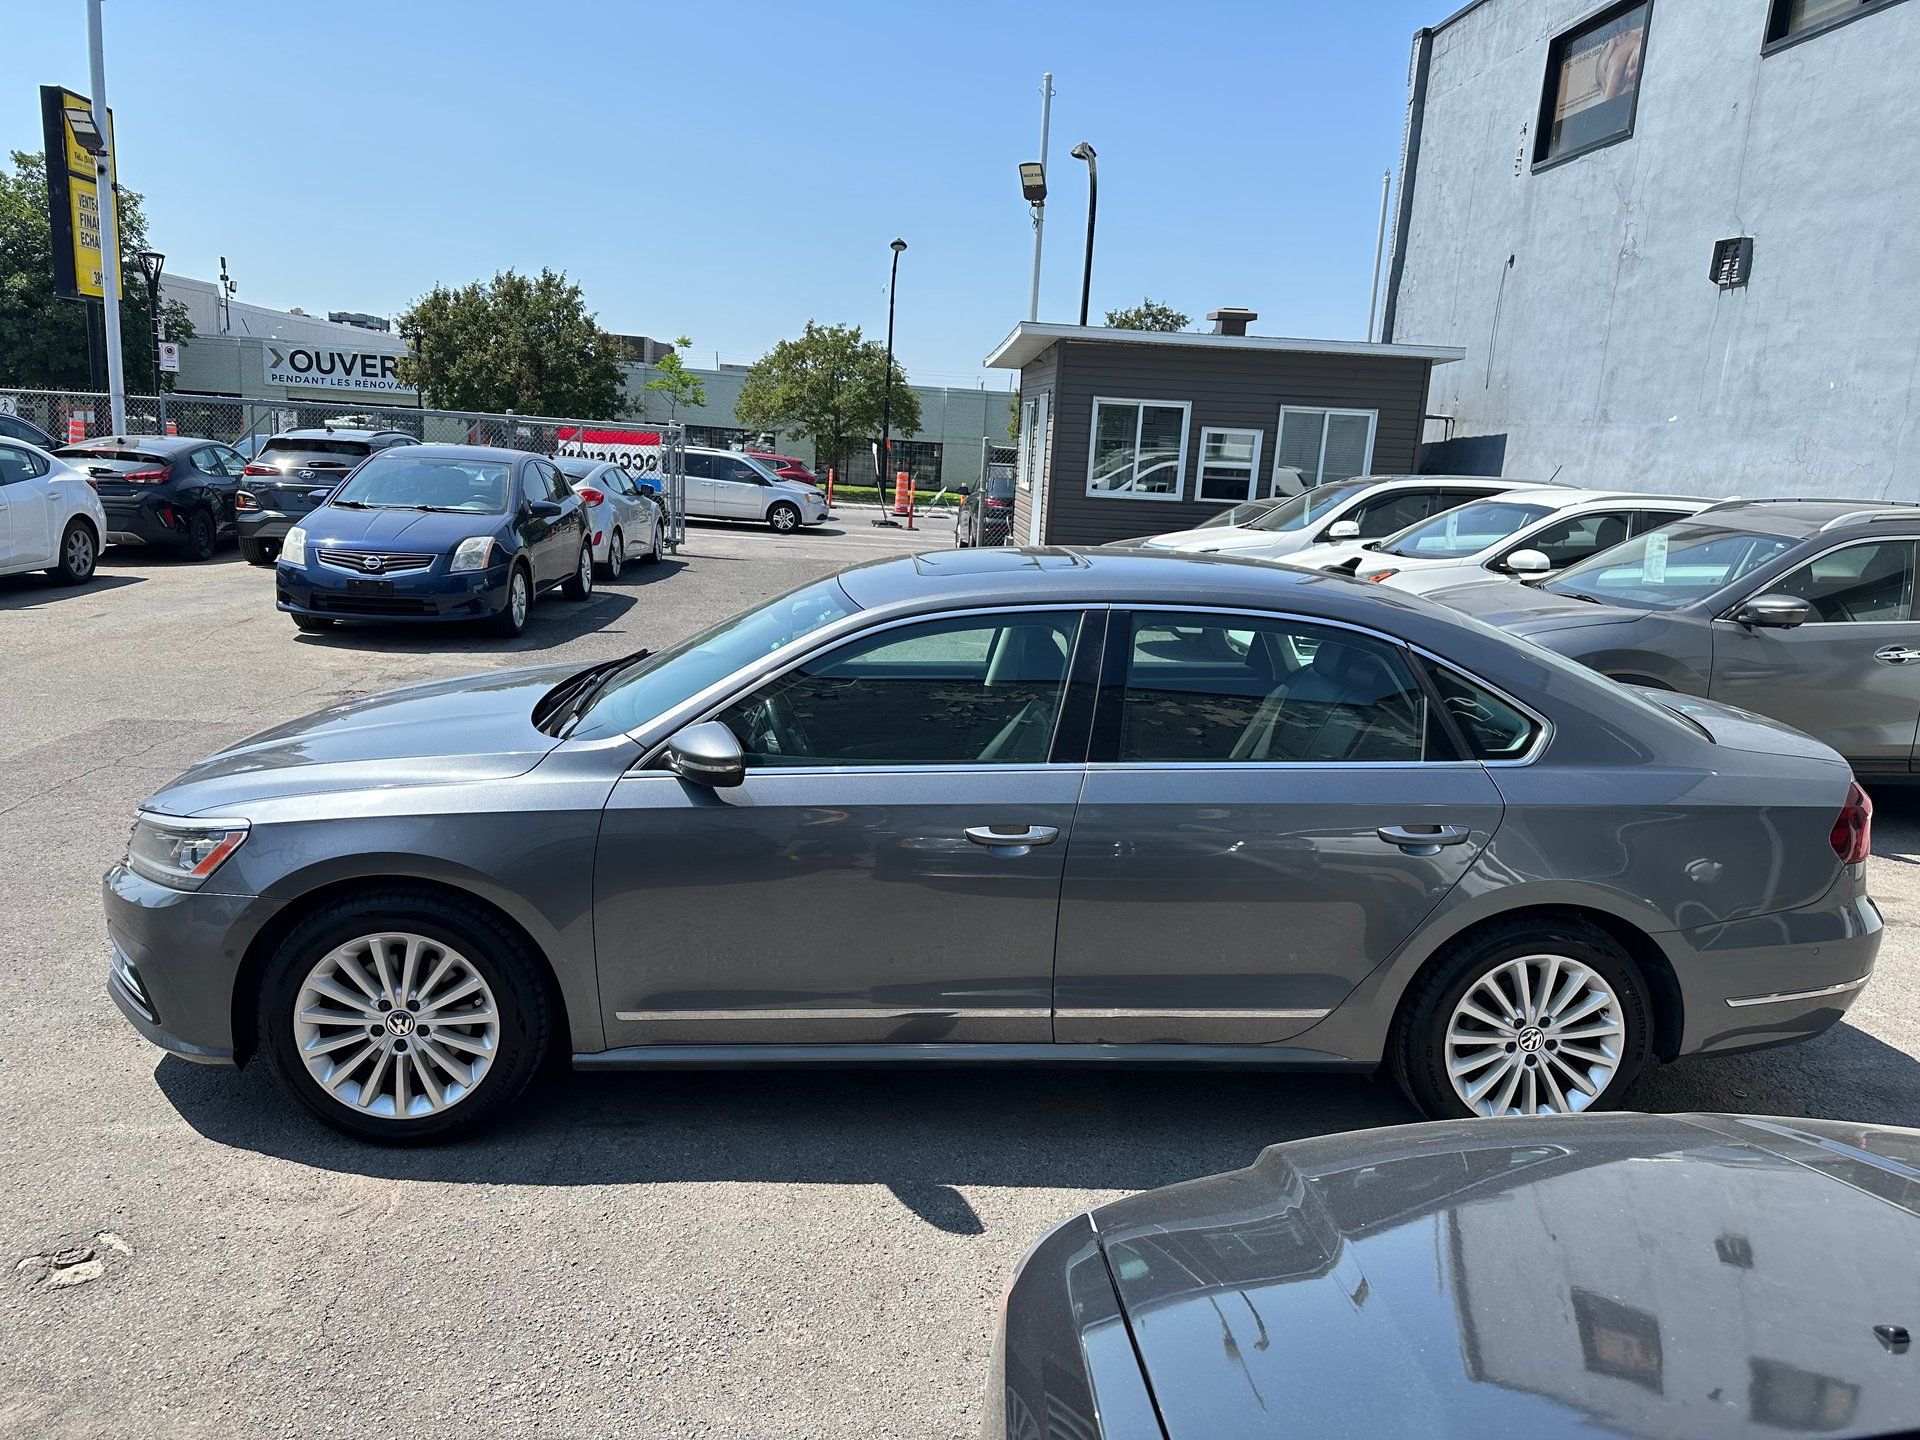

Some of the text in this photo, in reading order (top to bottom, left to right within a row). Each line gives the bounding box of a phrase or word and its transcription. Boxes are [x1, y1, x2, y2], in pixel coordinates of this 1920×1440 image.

[77, 192, 98, 212] VENTE-
[80, 231, 101, 249] ECHA
[289, 350, 398, 379] OUVER
[272, 374, 326, 385] PENDANT
[331, 378, 350, 387] LES
